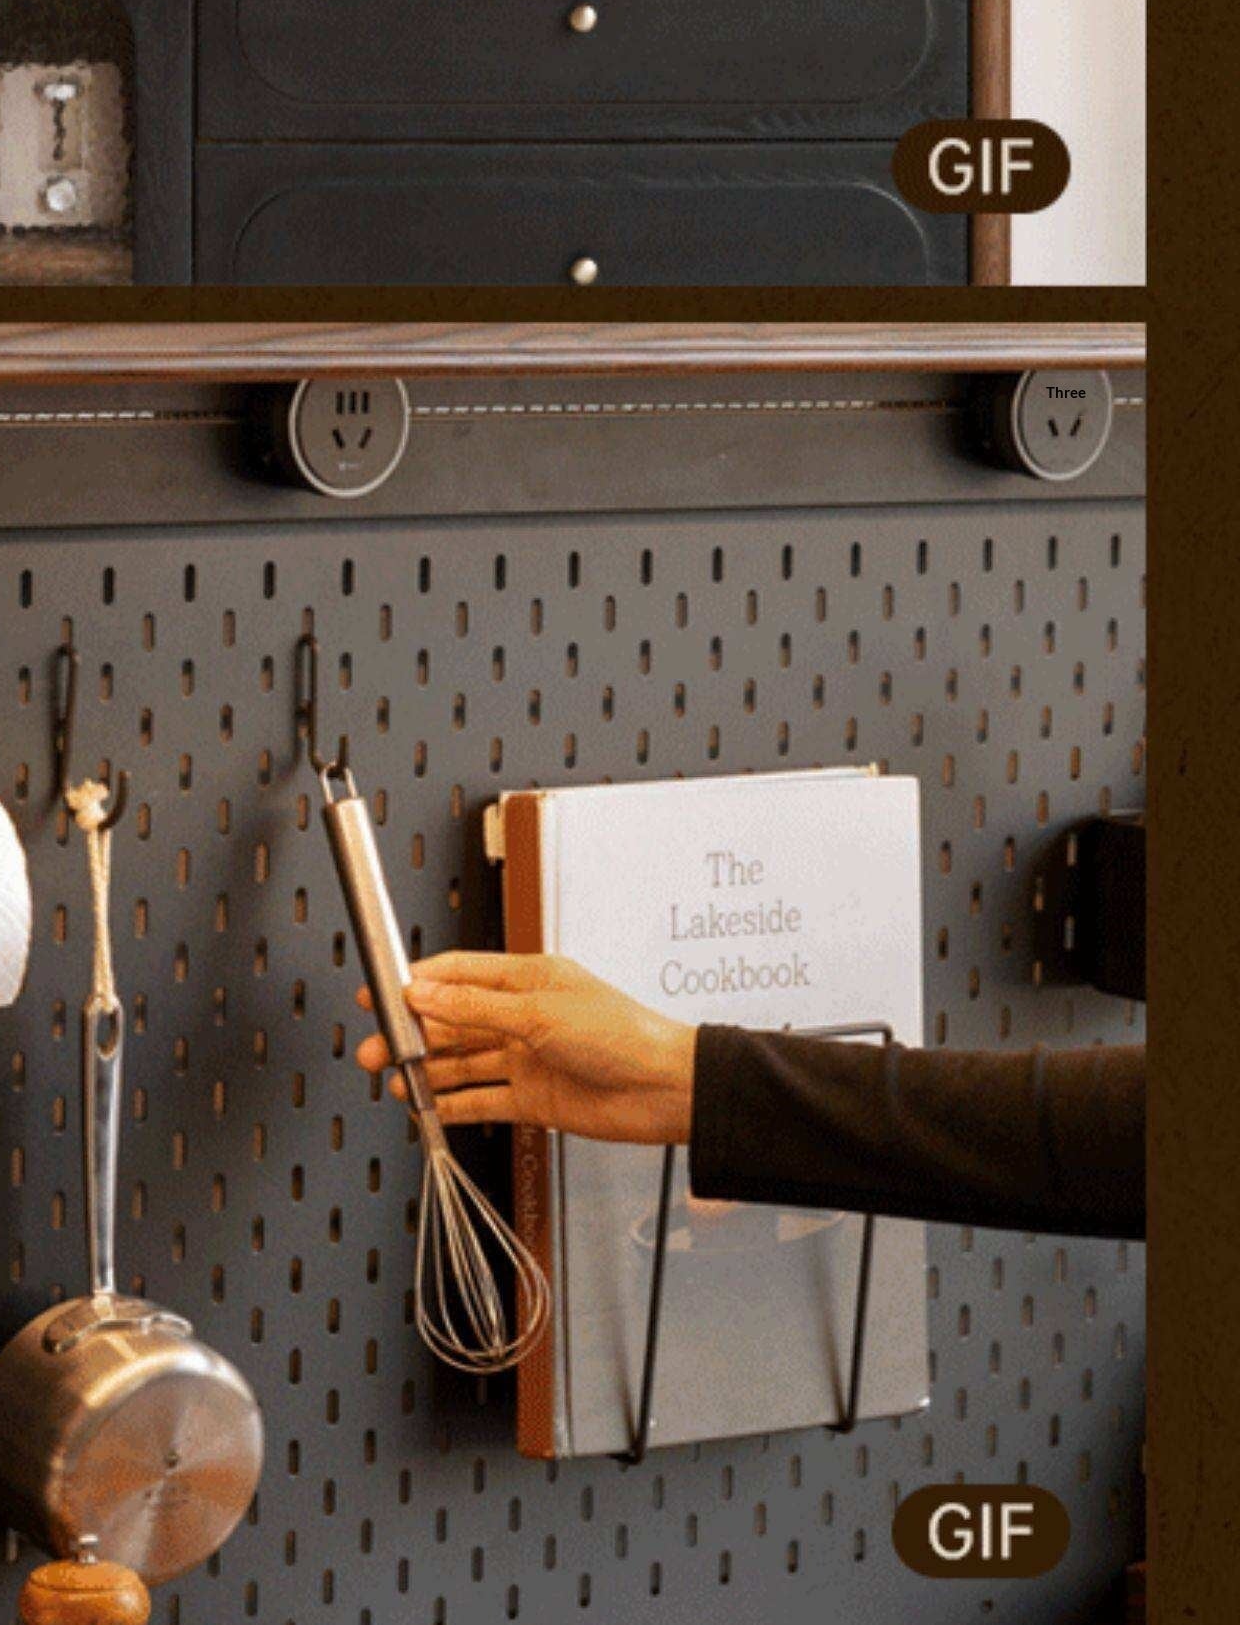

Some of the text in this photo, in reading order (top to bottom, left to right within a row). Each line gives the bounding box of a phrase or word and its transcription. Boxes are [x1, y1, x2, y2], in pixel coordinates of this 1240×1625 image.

[706, 850, 764, 887] The
[669, 899, 802, 941] Lakeside
[660, 952, 811, 996] Cookbook
